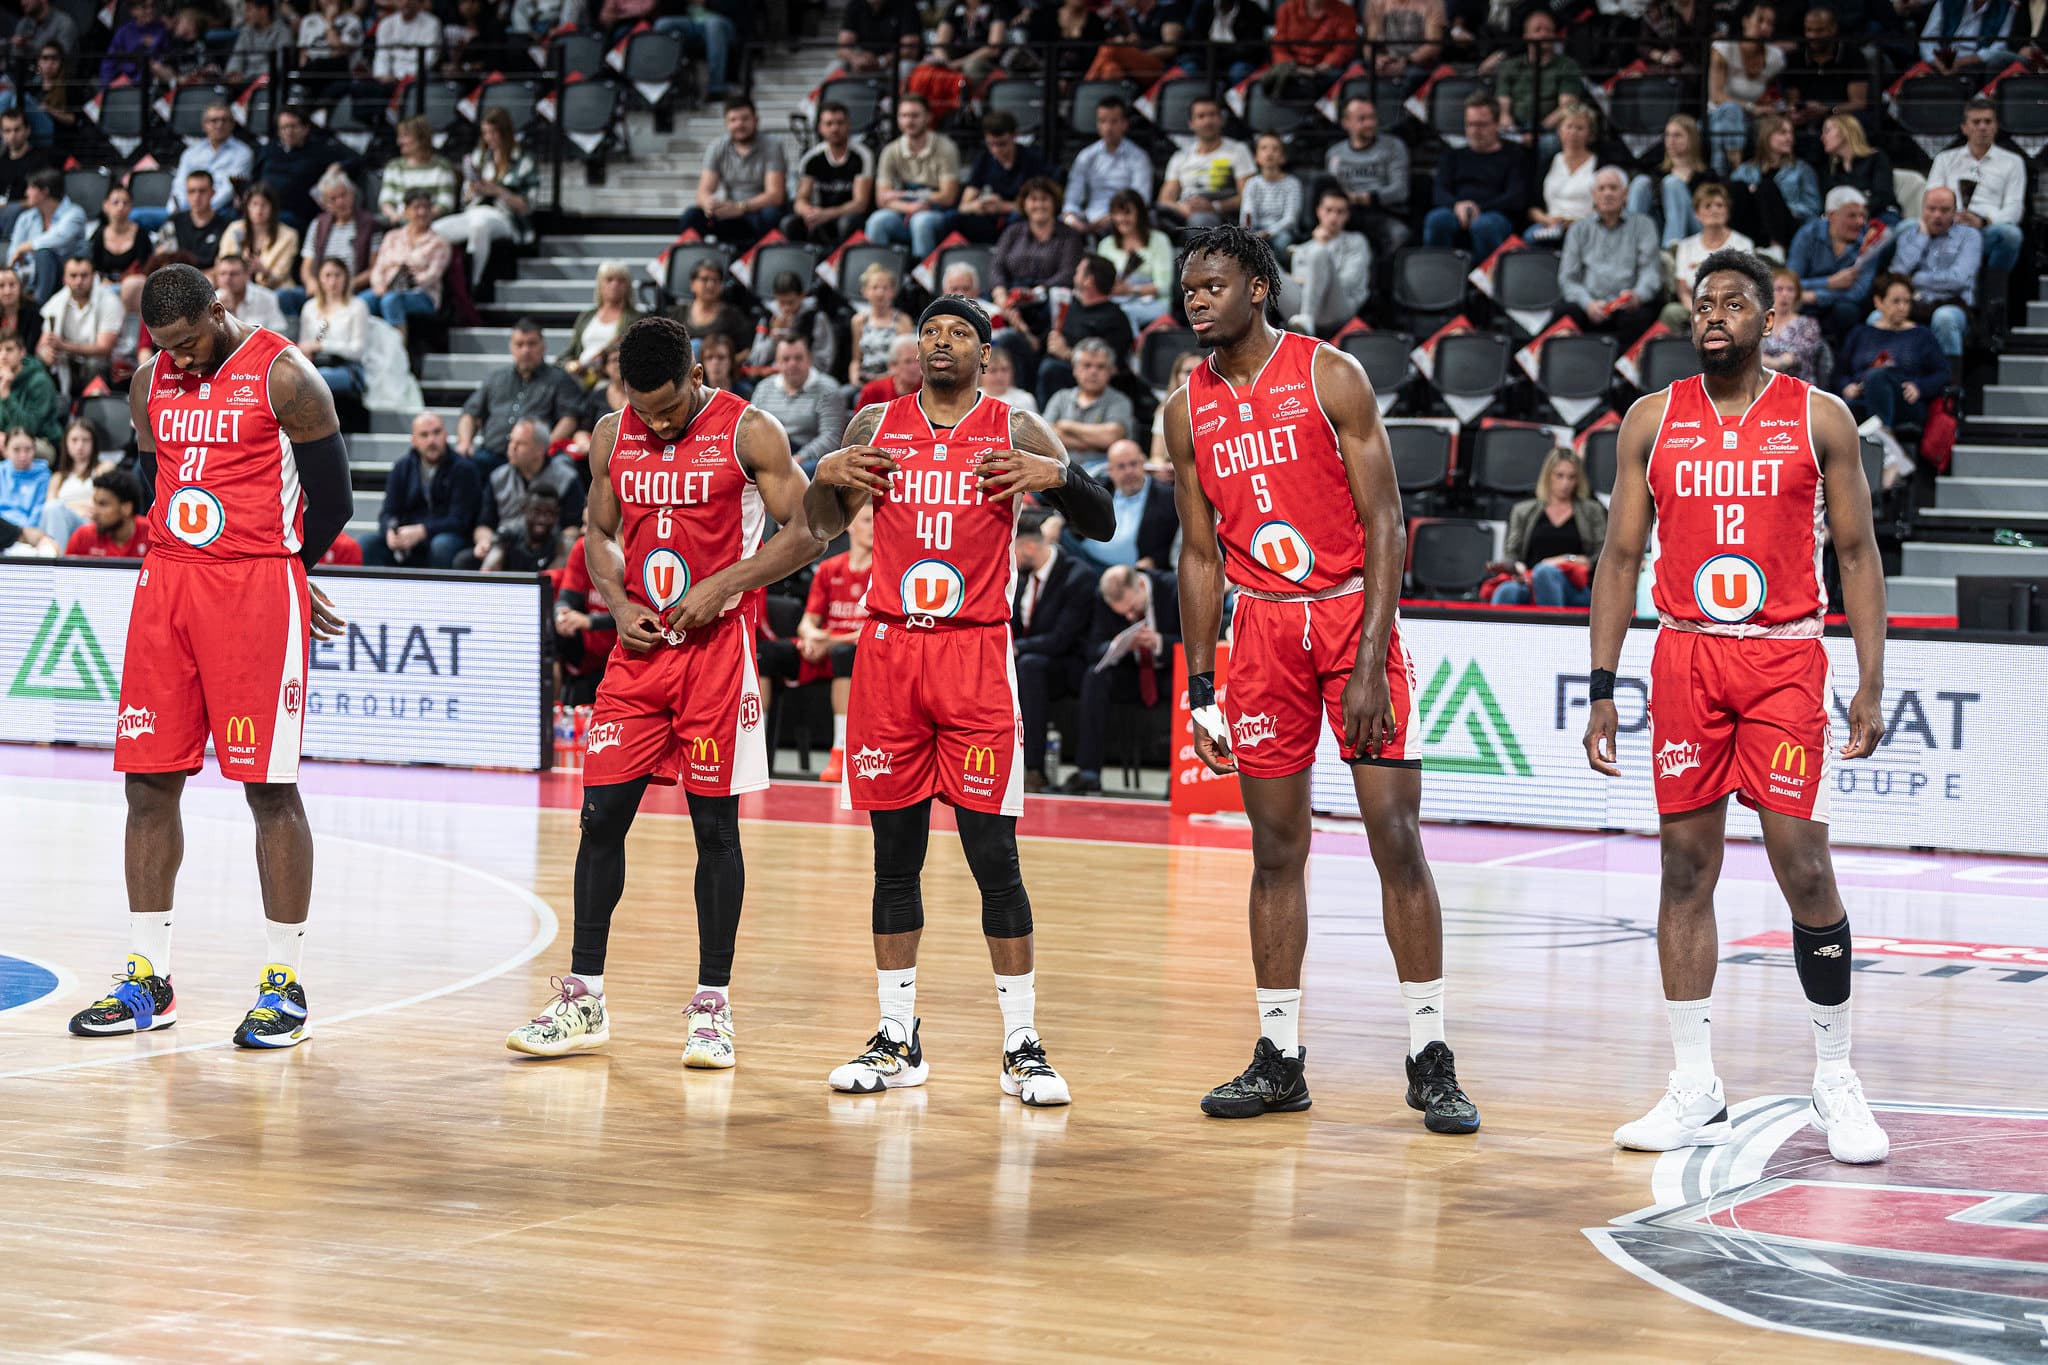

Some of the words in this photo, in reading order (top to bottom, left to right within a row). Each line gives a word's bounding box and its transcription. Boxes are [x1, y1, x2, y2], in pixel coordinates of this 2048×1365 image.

[1270, 382, 1306, 395] bio'bric
[158, 409, 244, 443] CHOLET
[1760, 419, 1800, 428] bio'bric
[178, 446, 209, 482] 21
[1212, 424, 1299, 478] CHOLET
[620, 470, 714, 505] CHOLET
[1250, 473, 1273, 514] 5
[1675, 459, 1784, 497] CHOLET
[179, 502, 208, 534] U
[657, 505, 673, 539] 6
[916, 511, 953, 550] 40
[1712, 503, 1745, 545] 12
[1261, 536, 1300, 573] U
[653, 566, 675, 599] U
[915, 577, 949, 611] U
[1711, 573, 1748, 609] U
[286, 686, 301, 710] CB
[308, 692, 460, 719] GROUPE
[740, 701, 759, 724] CB
[228, 745, 257, 754] CHOLET
[229, 756, 255, 765] SPALDING
[690, 762, 721, 772] CHOLET
[963, 773, 996, 785] CHOLET
[1769, 772, 1806, 787] CHOLET
[963, 784, 993, 797] SPALDING
[1769, 784, 1802, 800] SPALDING
[1839, 768, 1961, 799] OUPE
